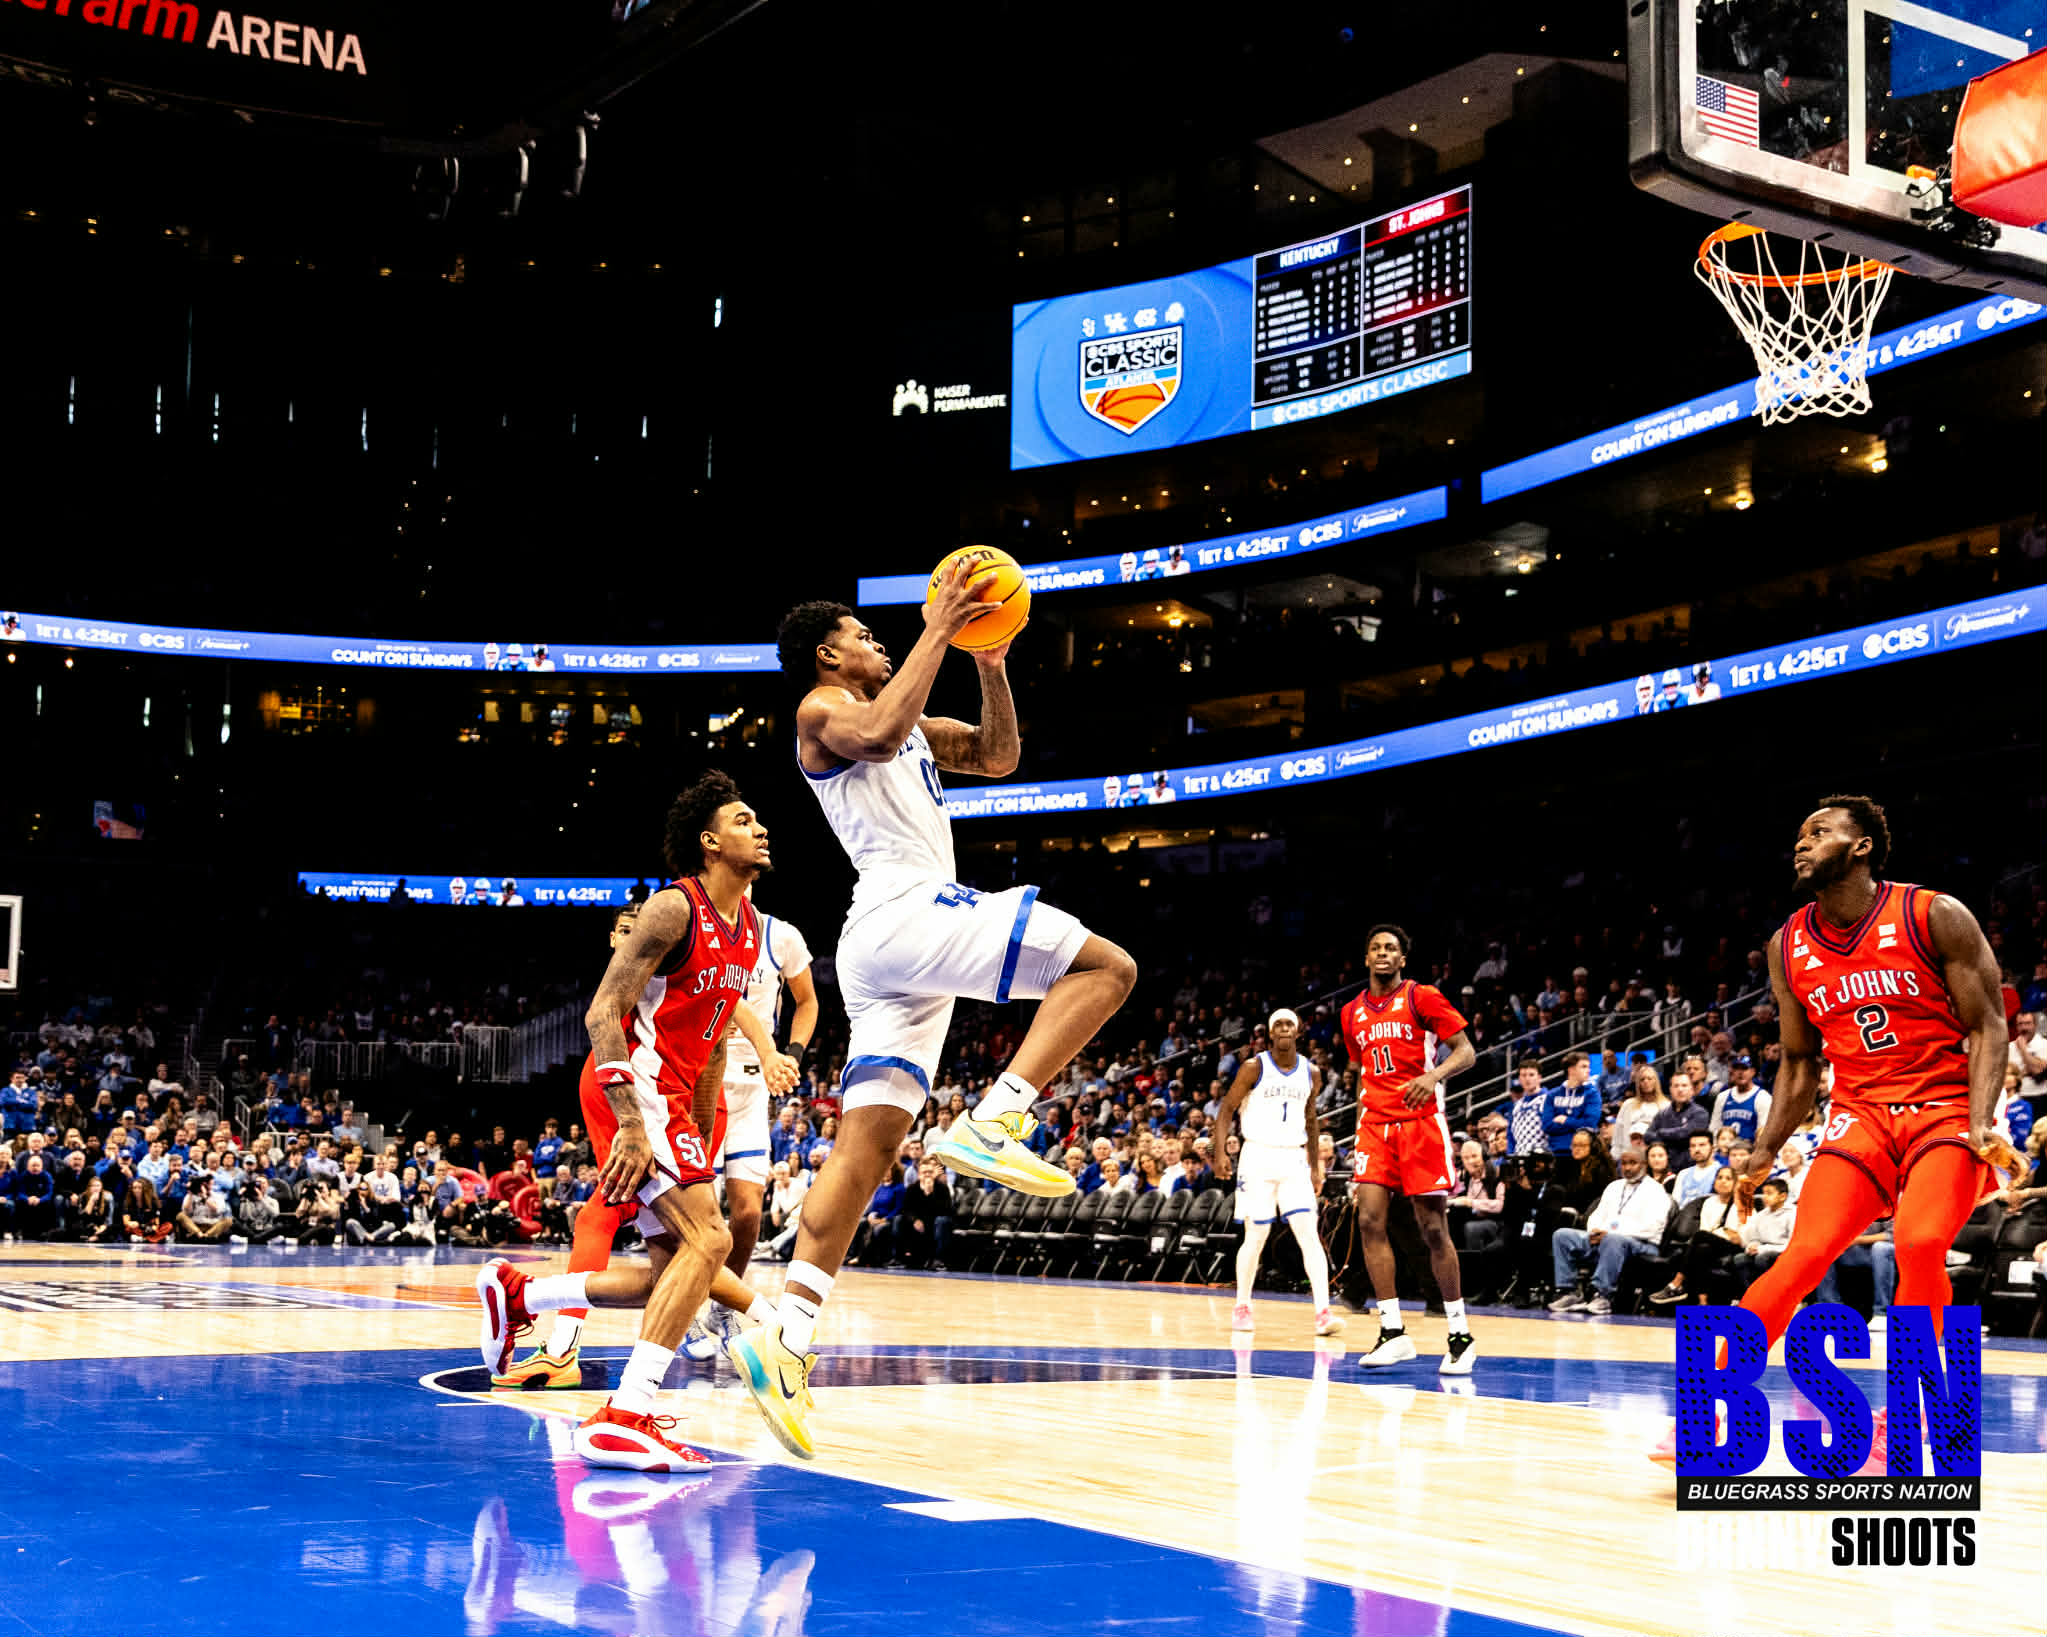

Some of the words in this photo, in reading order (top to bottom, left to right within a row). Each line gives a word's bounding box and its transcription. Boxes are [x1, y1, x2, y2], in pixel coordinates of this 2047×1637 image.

[207, 10, 367, 76] ARENA
[1280, 238, 1340, 268] KENTUCKY
[1126, 333, 1178, 353] SPORTS
[1086, 345, 1177, 377] CLASSIC
[1285, 400, 1318, 421] CBS
[1319, 382, 1379, 412] SPORTS
[1382, 361, 1449, 393] CLASSIC
[1669, 400, 1739, 439] SUNDAYS
[1312, 521, 1343, 543] CBS
[1040, 568, 1104, 590] SUNDAYS
[1883, 624, 1929, 654] CBS
[331, 648, 384, 663] COUNT
[384, 651, 408, 665] ON
[409, 652, 473, 667] SUNDAYS
[1468, 720, 1521, 747] COUNT
[1521, 715, 1547, 735] ON
[1547, 699, 1618, 730] SUNDAYS
[1293, 756, 1326, 777] CBS
[993, 797, 1019, 814] ON
[1020, 792, 1088, 812] SUNDAYS
[693, 966, 719, 994] ST.
[1807, 984, 1836, 1017] ST.
[1836, 969, 1920, 1004] JOHN'S
[702, 999, 727, 1040] 1
[1368, 1021, 1413, 1040] JOHN'S
[1854, 1003, 1899, 1053] 2
[1371, 1044, 1396, 1076] 11
[1282, 1101, 1288, 1122] 1
